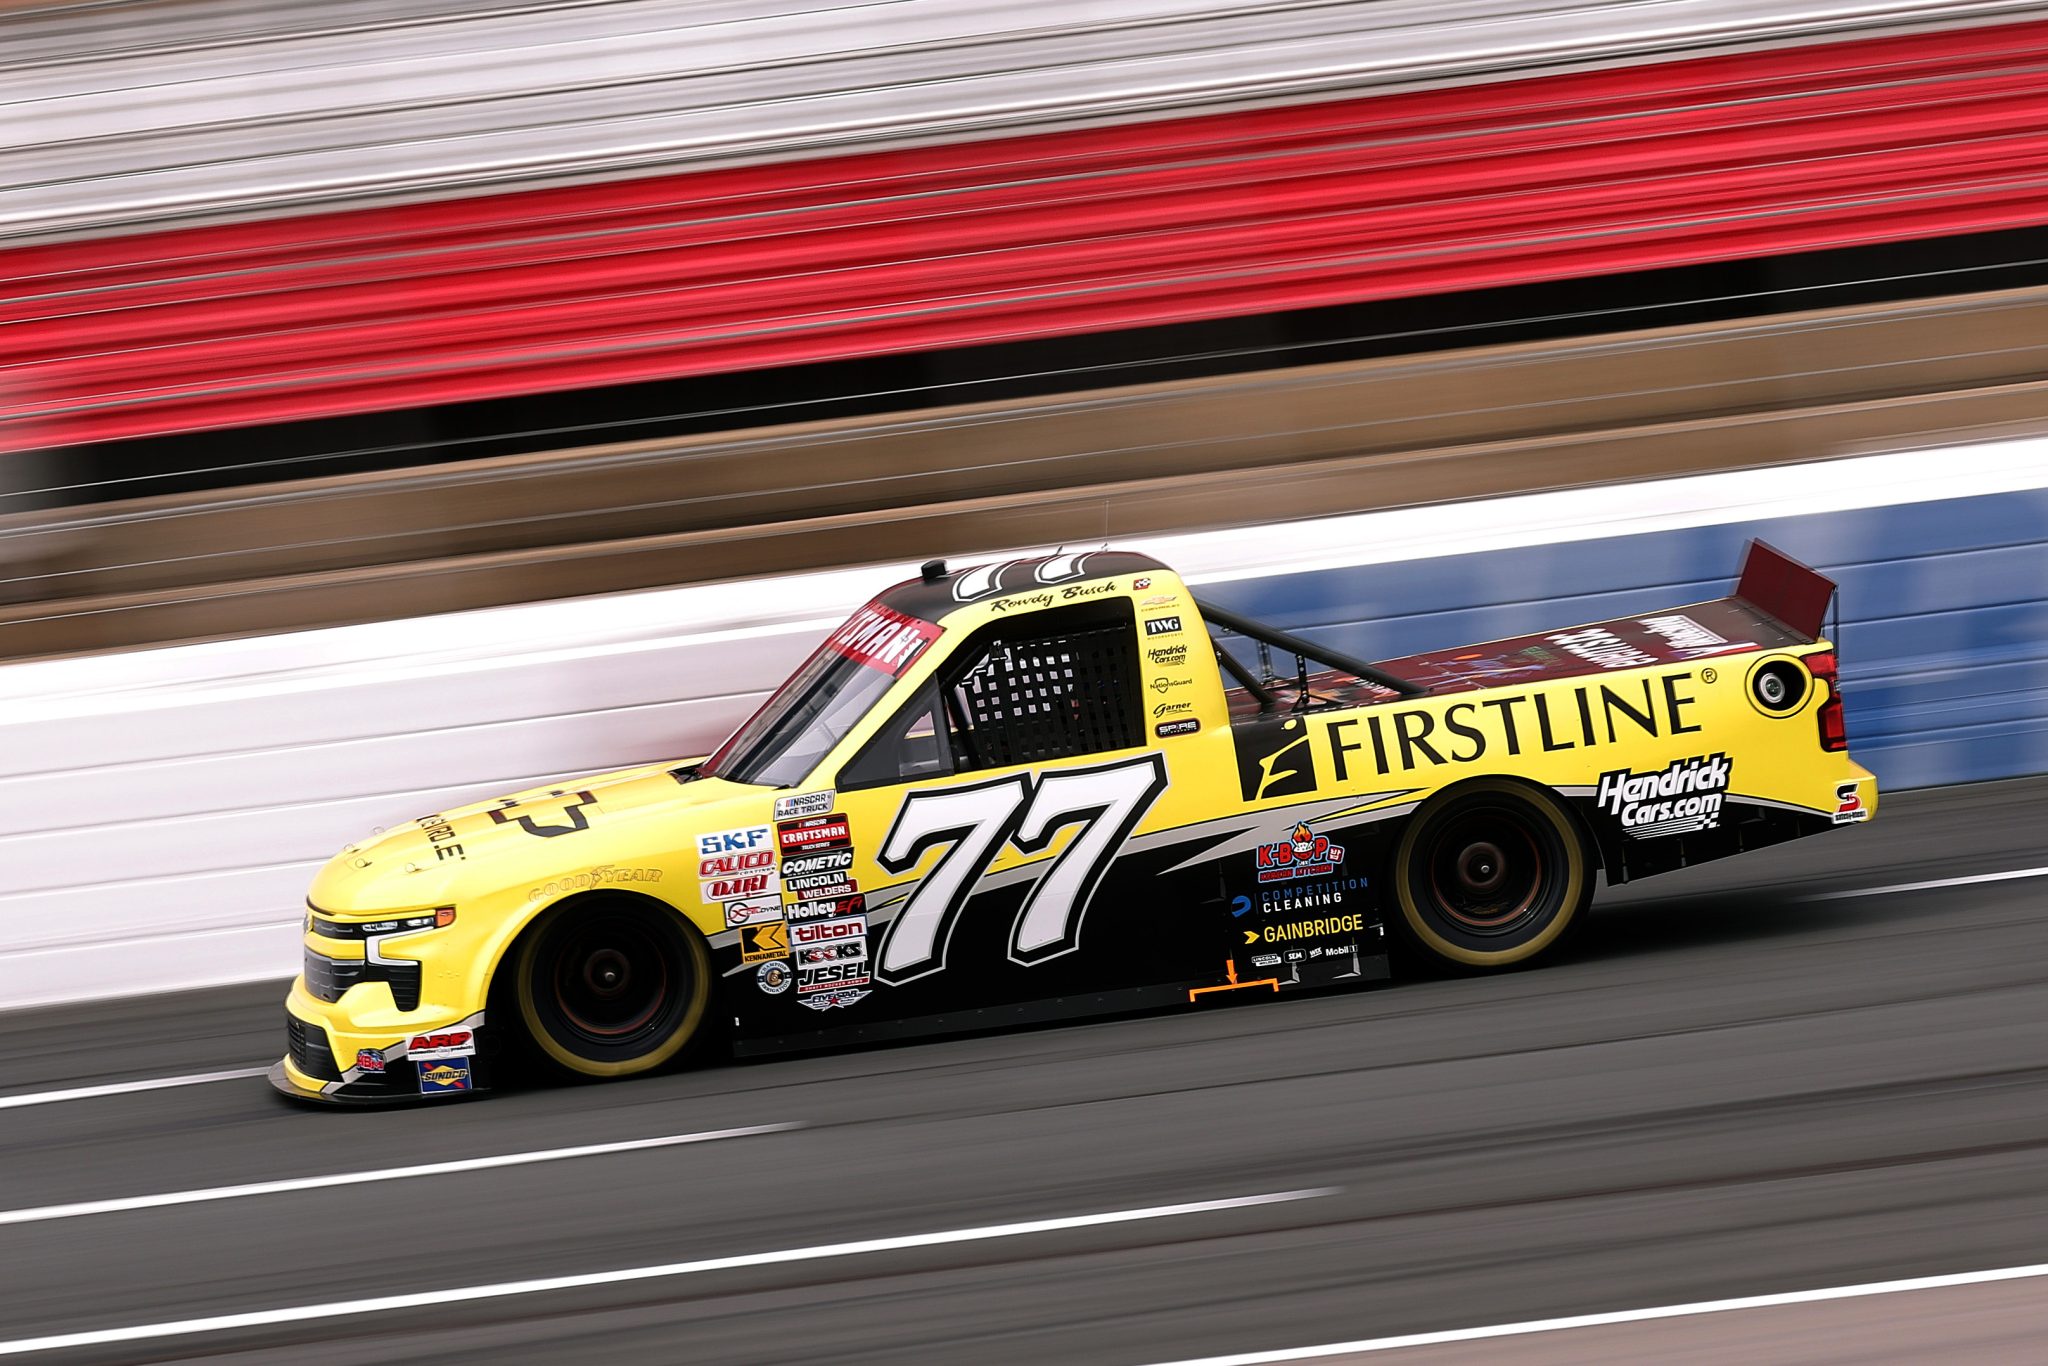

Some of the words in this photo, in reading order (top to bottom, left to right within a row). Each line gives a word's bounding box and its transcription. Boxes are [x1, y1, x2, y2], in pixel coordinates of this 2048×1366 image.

[990, 594, 1054, 612] Rowdy
[1061, 581, 1117, 599] Busch
[1146, 618, 1179, 633] TWG
[1147, 644, 1188, 660] Hendrick
[1149, 678, 1193, 690] NationsGuard
[1153, 702, 1191, 719] Garner
[1597, 756, 1729, 815] Hendrick
[777, 807, 799, 817] RACE
[801, 803, 828, 813] TRUCK
[1621, 793, 1722, 827] Cars.com
[701, 828, 768, 855] SKF
[782, 825, 846, 844] CRAFTSMAN
[700, 850, 774, 876] CALICO
[782, 852, 852, 875] COMETIC
[876, 752, 1168, 983] 77
[528, 865, 663, 902] GOODYEAR
[788, 872, 845, 891] LINCOLN
[1261, 877, 1369, 902] COMPETITION
[802, 884, 852, 899] WELDERS
[787, 901, 837, 919] Holley
[1263, 892, 1342, 913] CLEANING
[795, 922, 863, 941] tilton
[1263, 914, 1364, 943] GAINBRIDGE
[745, 950, 788, 962] KENNAMETAL
[1288, 952, 1303, 960] SEM
[1325, 946, 1349, 956] Mobil
[798, 961, 870, 986] JESEL
[408, 1031, 472, 1050] ARP
[425, 1069, 466, 1081] SUNOCO
